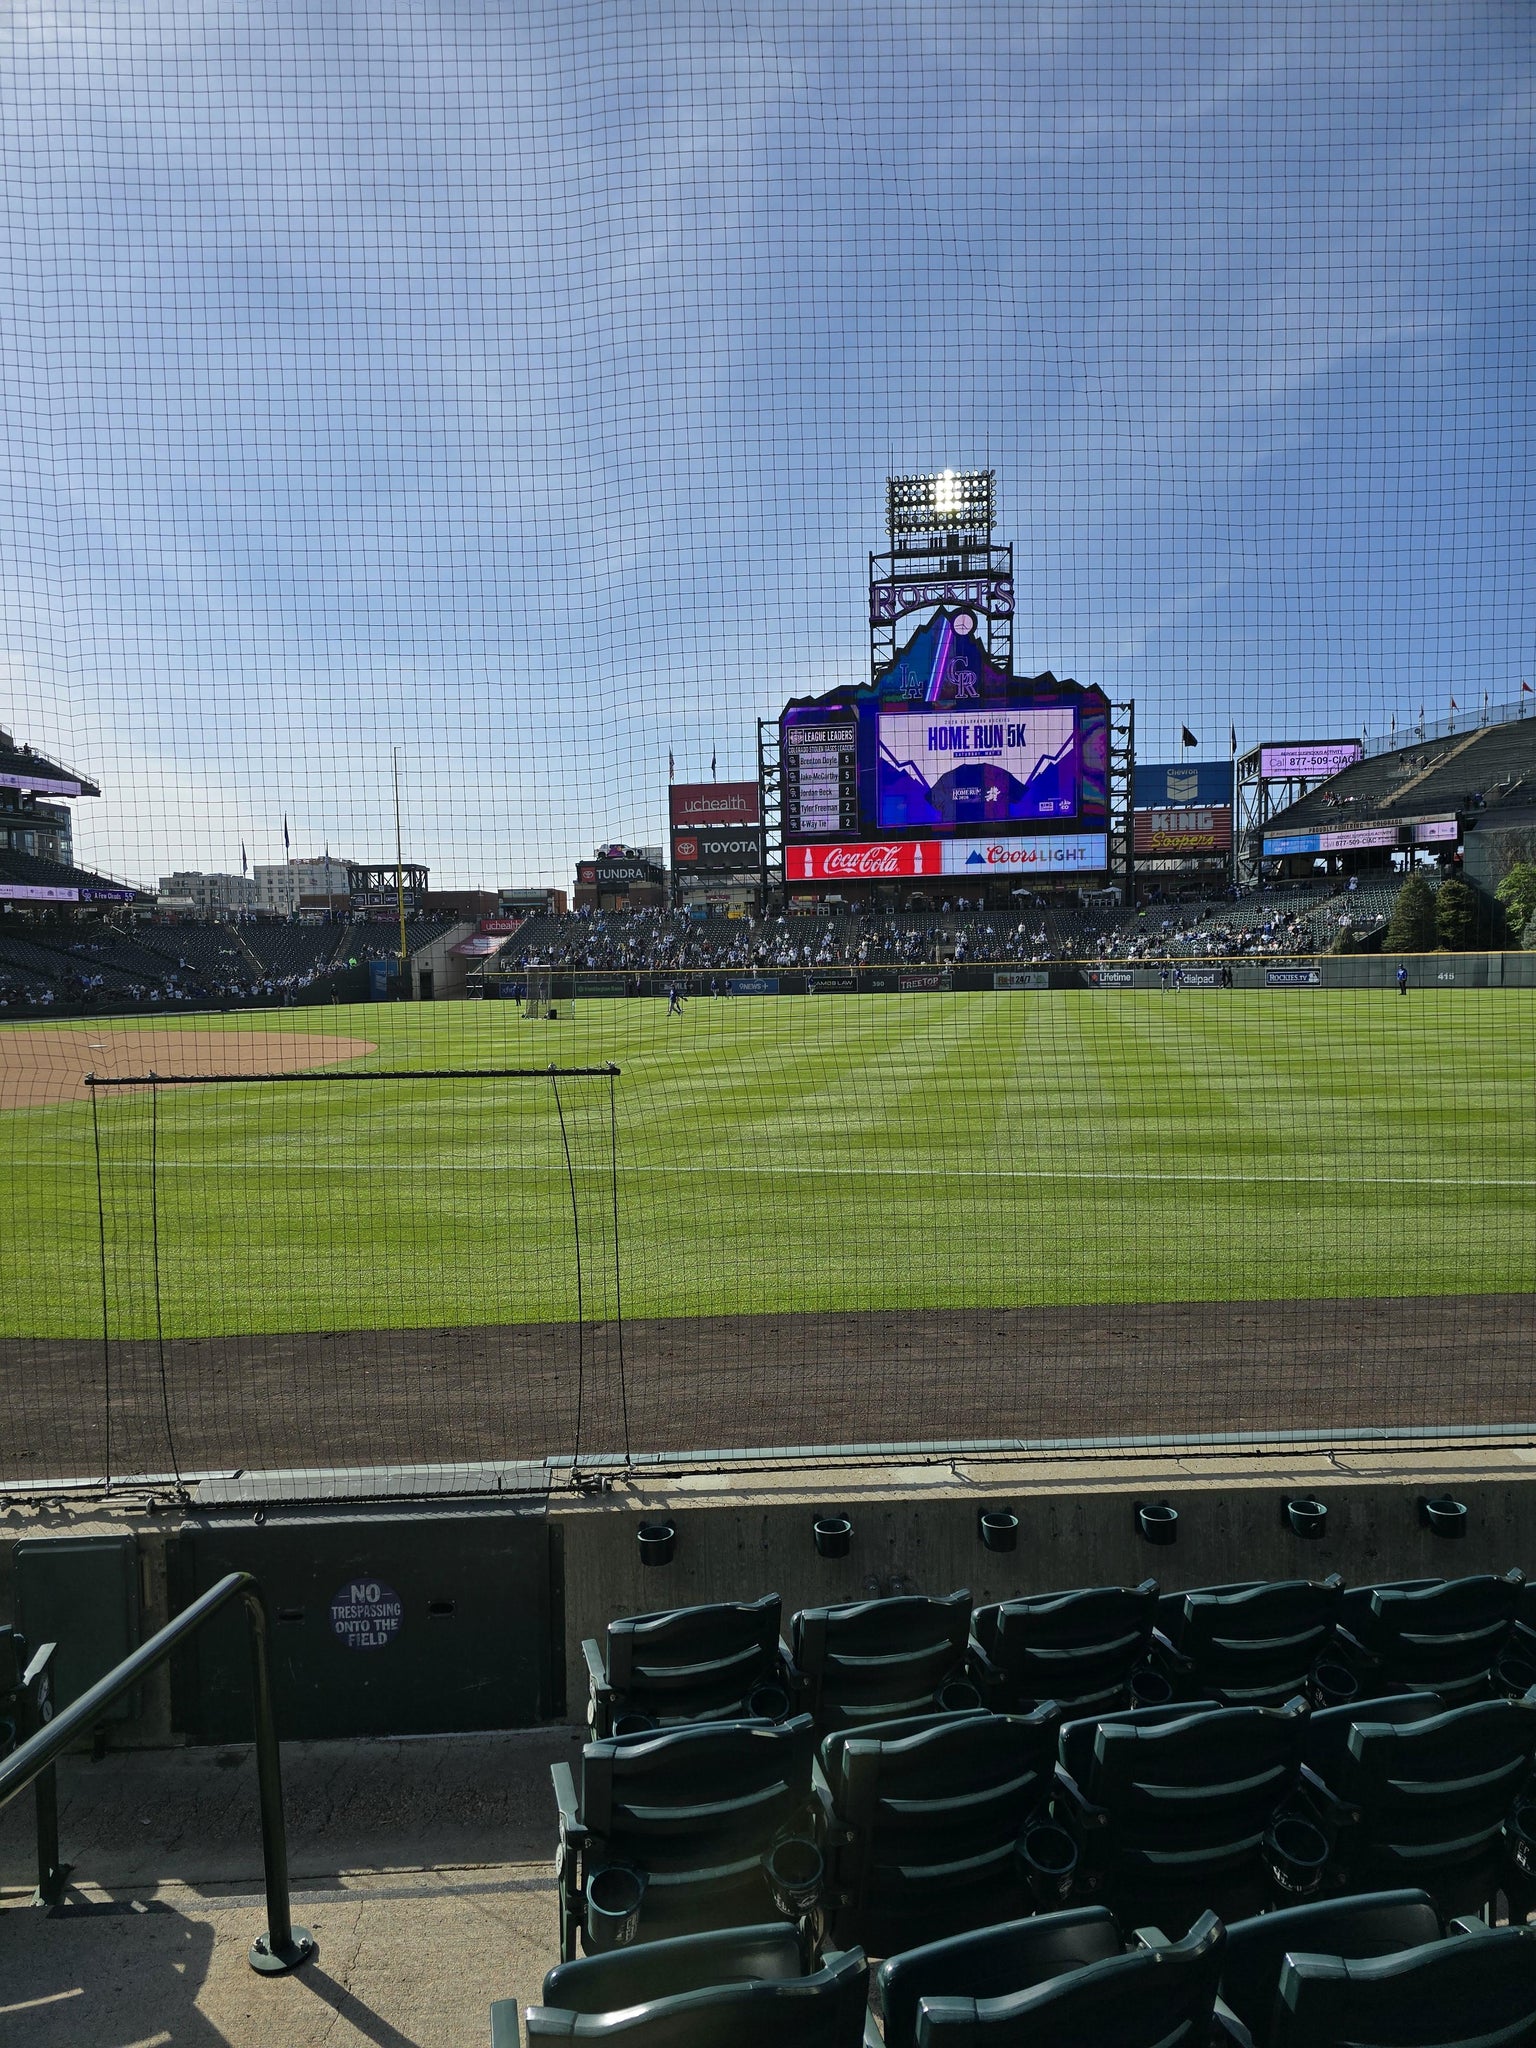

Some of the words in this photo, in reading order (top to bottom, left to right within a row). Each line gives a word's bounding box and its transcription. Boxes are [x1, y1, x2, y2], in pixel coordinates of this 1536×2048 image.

[869, 579, 1015, 621] ROCKIES
[804, 731, 826, 742] LEAGUE
[827, 730, 853, 741] LEADERS
[928, 725, 970, 751] HOME
[973, 724, 1003, 749] RUN
[1007, 723, 1026, 748] 5K
[822, 757, 837, 765] Doyle
[845, 755, 849, 763] 5
[1289, 755, 1355, 766] 877-509-CIAC
[800, 772, 812, 780] Jake
[813, 770, 838, 781] McCarthy
[845, 771, 850, 779] 5
[1166, 768, 1198, 776] Chevron
[800, 788, 818, 797] Jordan
[819, 788, 832, 796] Beck
[845, 787, 850, 795] 2
[684, 794, 746, 812] uchealth
[801, 805, 814, 813] Tyler
[815, 803, 838, 812] Freeman
[845, 803, 850, 811] 2
[801, 820, 817, 829] 4-Way
[818, 820, 827, 828] Tie
[845, 819, 850, 827] 2
[1151, 812, 1214, 832] KING
[1308, 826, 1333, 834] PROUDLY
[1334, 823, 1364, 831] POWERING
[1372, 818, 1403, 827] COLORADO
[702, 840, 757, 853] TOYOTA
[1151, 831, 1214, 850] Soopers
[823, 846, 902, 874] Coca-Cola
[987, 845, 1038, 864] Coors
[1040, 848, 1087, 862] LIGHT
[596, 868, 643, 879] TUNDRA
[485, 920, 521, 931] uchealth
[1099, 972, 1132, 982] Lifetime
[1183, 973, 1214, 985] dialpad
[1437, 972, 1455, 980] 415
[351, 1584, 381, 1603] NO
[331, 1602, 401, 1620] TRESPASSING
[335, 1619, 371, 1634] ONTO
[373, 1618, 399, 1631] THE
[348, 1631, 388, 1647] FIELD
